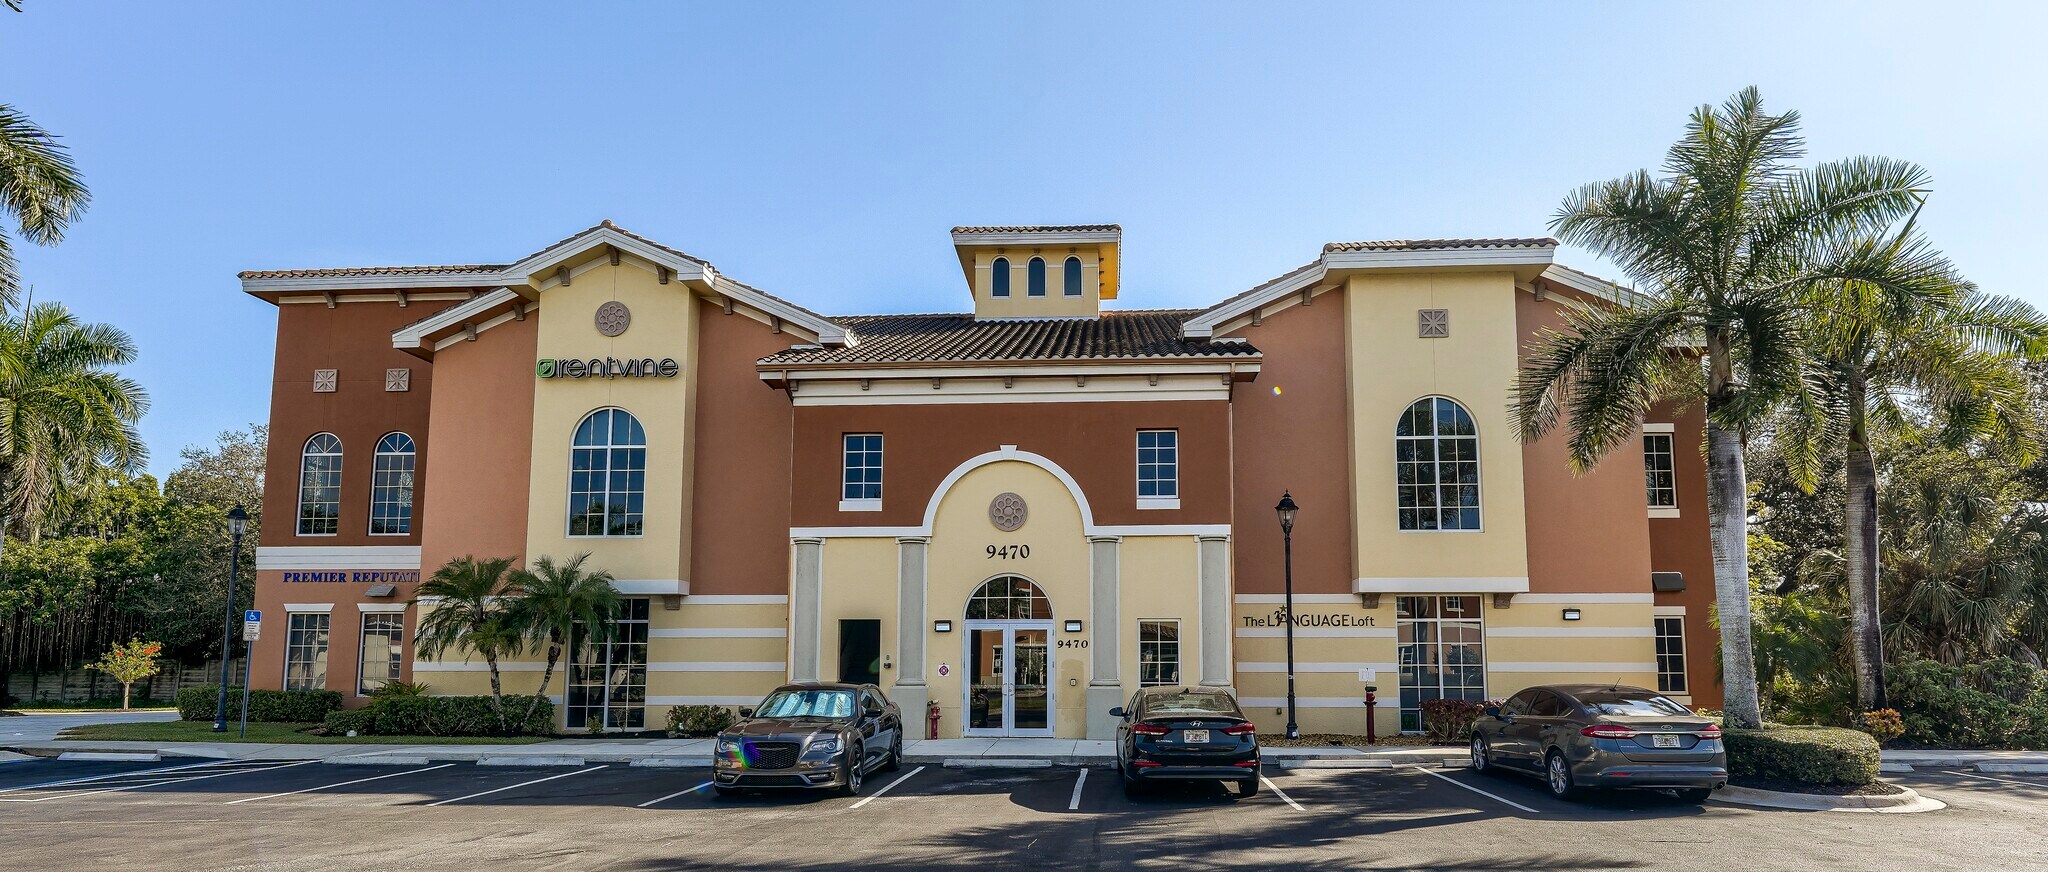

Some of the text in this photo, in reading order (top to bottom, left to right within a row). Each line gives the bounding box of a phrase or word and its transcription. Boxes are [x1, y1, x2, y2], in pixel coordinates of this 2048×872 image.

[557, 356, 679, 381] rentvine
[986, 544, 1030, 560] 9470
[283, 572, 347, 583] PREMIER
[1243, 616, 1265, 627] The
[1351, 616, 1375, 627] Loft
[1057, 639, 1089, 649] 9470
